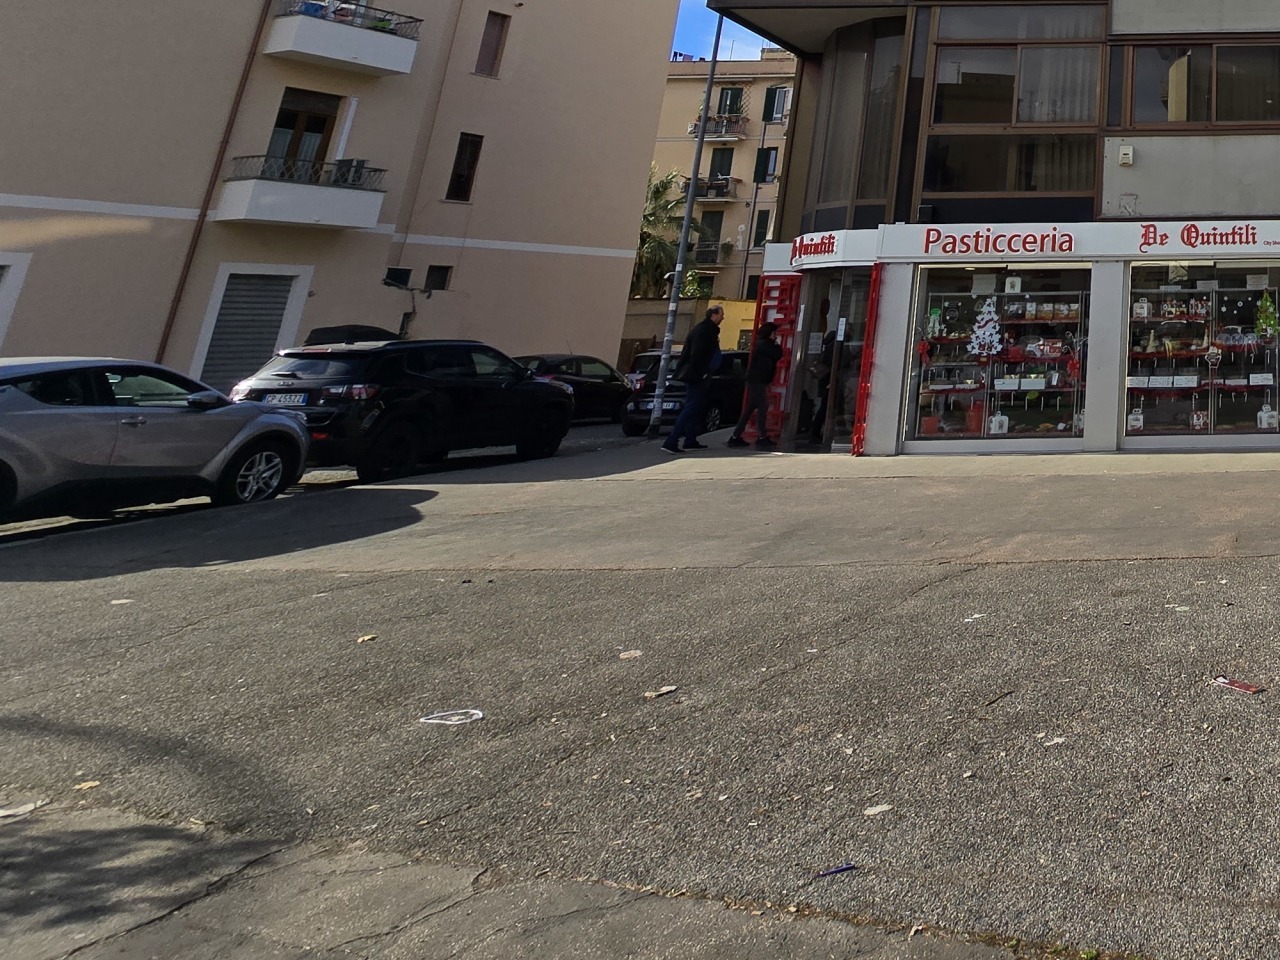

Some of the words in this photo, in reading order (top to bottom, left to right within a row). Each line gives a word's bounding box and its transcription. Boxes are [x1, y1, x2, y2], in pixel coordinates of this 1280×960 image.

[923, 226, 1076, 255] Pasticceria
[1138, 223, 1170, 254] De
[1179, 223, 1258, 248] Quintili
